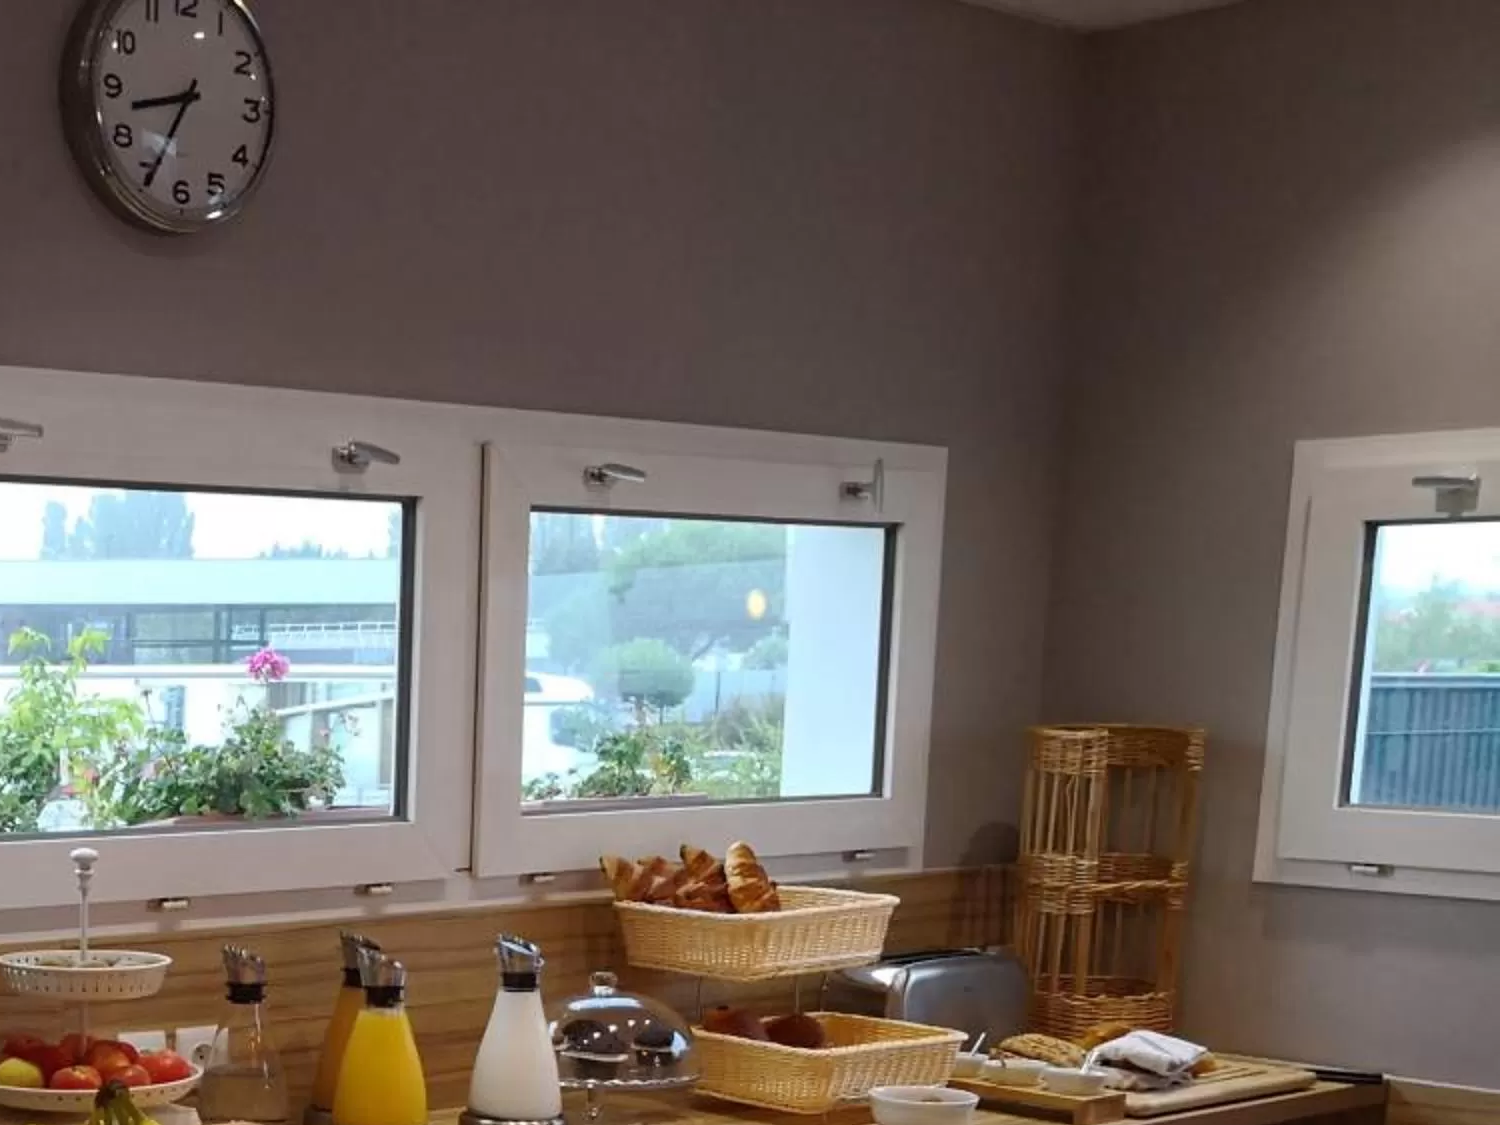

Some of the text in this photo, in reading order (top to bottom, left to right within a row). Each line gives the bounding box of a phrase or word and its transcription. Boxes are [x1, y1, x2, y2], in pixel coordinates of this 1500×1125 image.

[146, 0, 159, 23] 11
[175, 0, 198, 18] 12
[217, 11, 224, 37] 1
[116, 29, 136, 55] 10
[233, 51, 252, 76] 2
[103, 73, 123, 98] 9
[242, 98, 261, 124] 3
[113, 123, 133, 148] 8
[232, 144, 249, 168] 4
[172, 180, 190, 204] 6
[206, 172, 225, 197] 5
